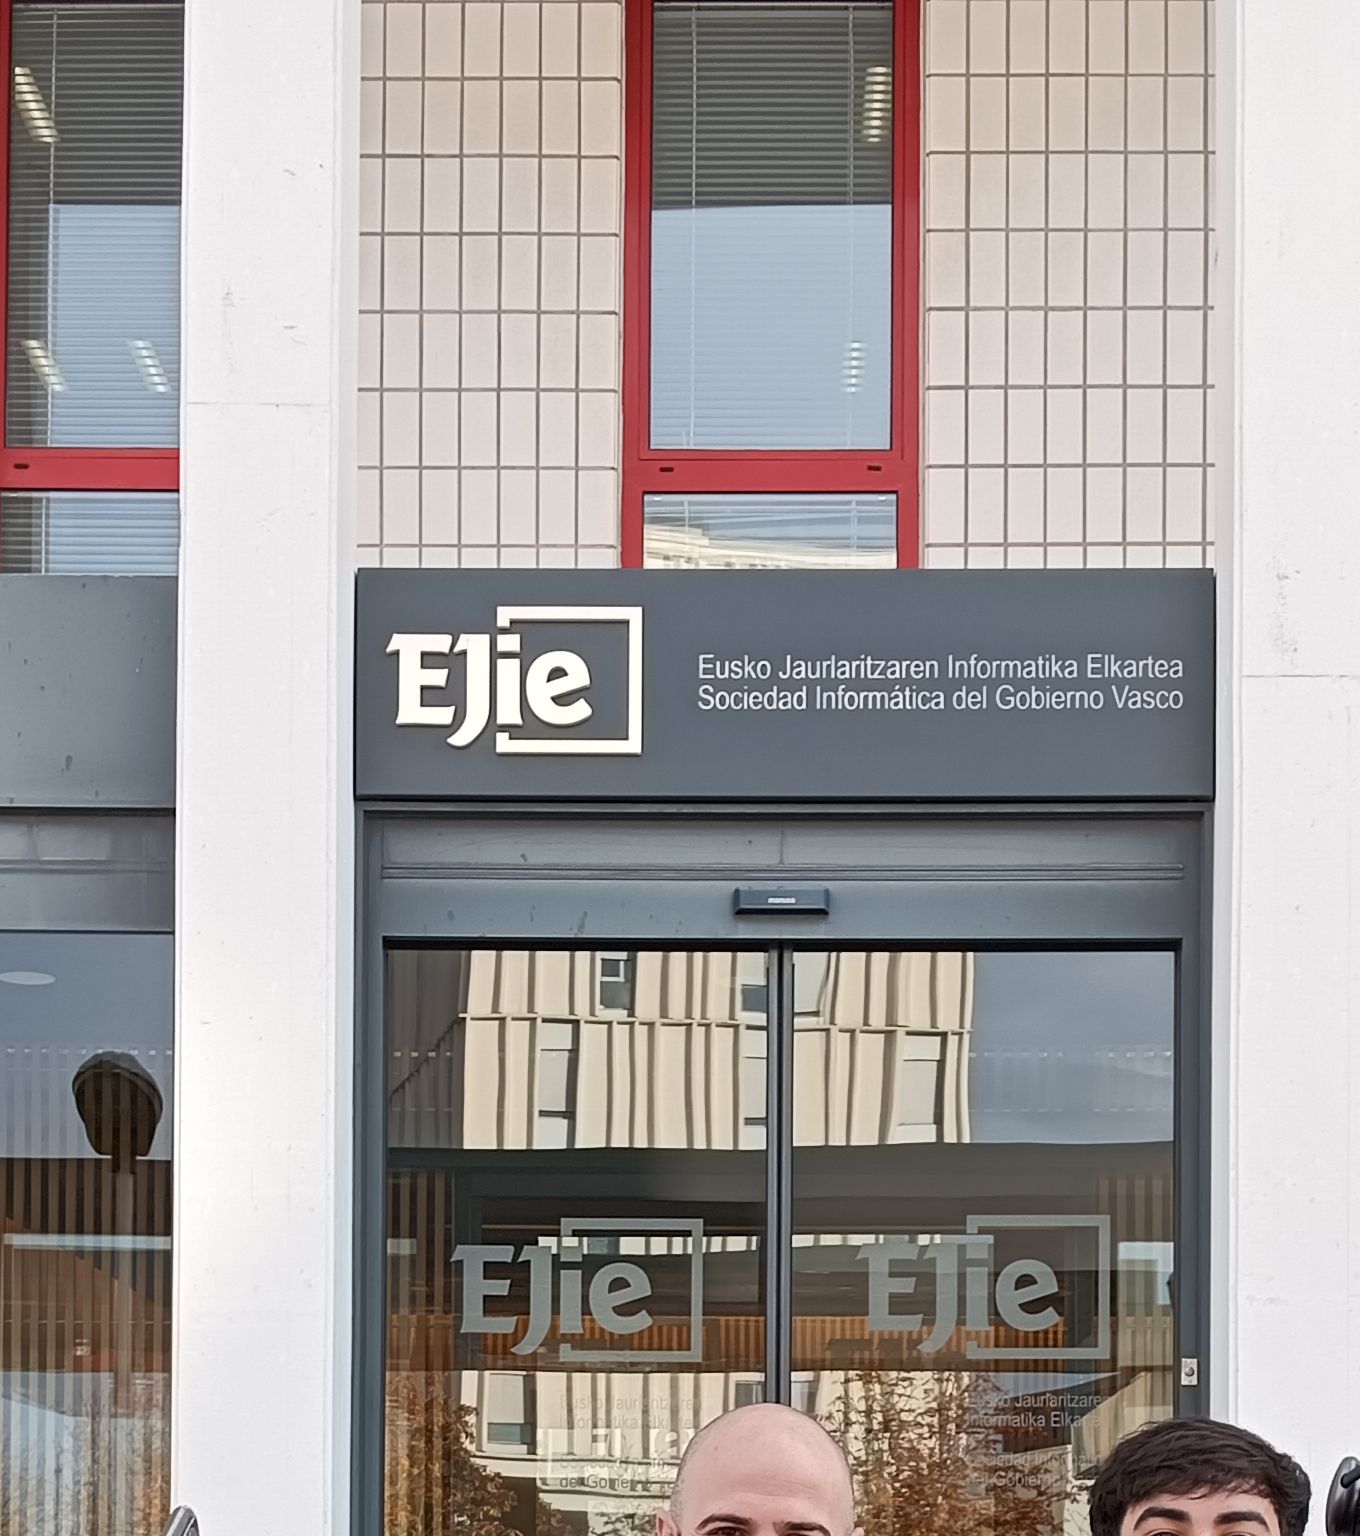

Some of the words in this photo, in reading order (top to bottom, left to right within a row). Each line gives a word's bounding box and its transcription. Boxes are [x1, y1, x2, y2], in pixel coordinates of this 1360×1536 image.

[386, 633, 593, 748] EJie
[697, 653, 772, 680] Eusko
[778, 653, 939, 680] Jaurlaritzaren
[947, 653, 1078, 679] Informatika
[1087, 653, 1184, 679] Elkartea
[697, 684, 807, 710] Sociedad
[815, 684, 945, 710] Informática
[952, 684, 987, 710] del
[995, 684, 1104, 710] Gobierno
[1111, 684, 1184, 710] Vasco
[450, 1244, 654, 1356] EJie
[855, 1242, 1061, 1353] EJie
